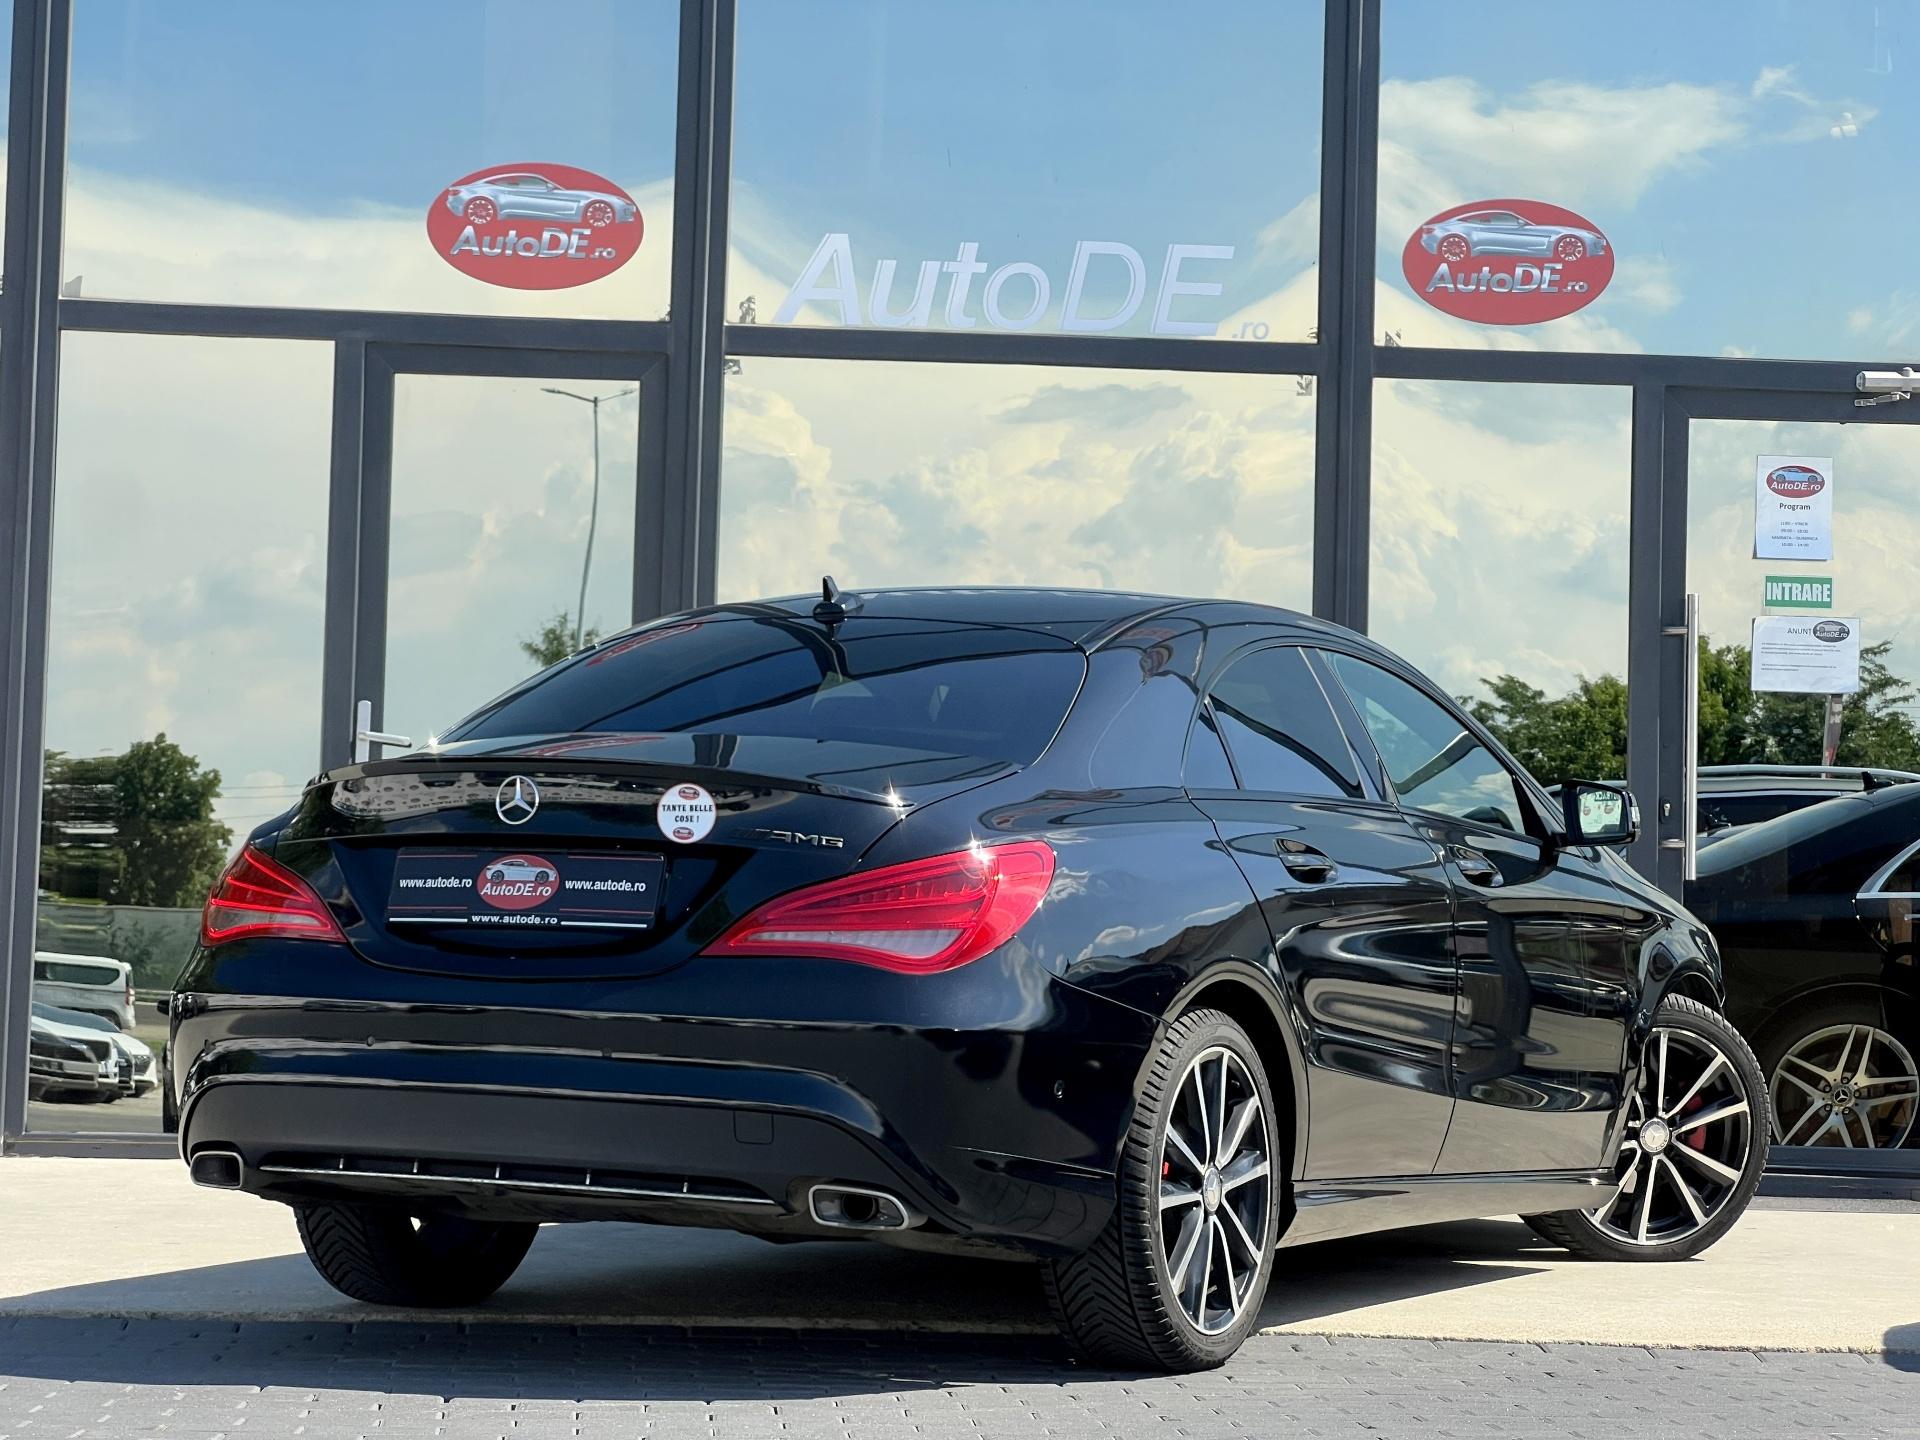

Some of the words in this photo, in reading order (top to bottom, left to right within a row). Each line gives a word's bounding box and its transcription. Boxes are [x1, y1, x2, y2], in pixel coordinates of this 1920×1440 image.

[450, 225, 616, 259] AutoDE.ro
[1425, 262, 1589, 293] AutoDE.ro
[1771, 481, 1821, 491] AutoDE.ro
[1779, 502, 1811, 511] Program
[1766, 582, 1831, 602] INTRARE
[662, 804, 687, 812] TANTE
[689, 804, 713, 812] BELLE
[674, 815, 694, 823] COSE
[399, 877, 472, 888] www.autode.ro
[565, 879, 647, 892] www.autode.ro
[480, 882, 551, 897] AutoDE.ro
[471, 913, 558, 925] www.autode.ro
